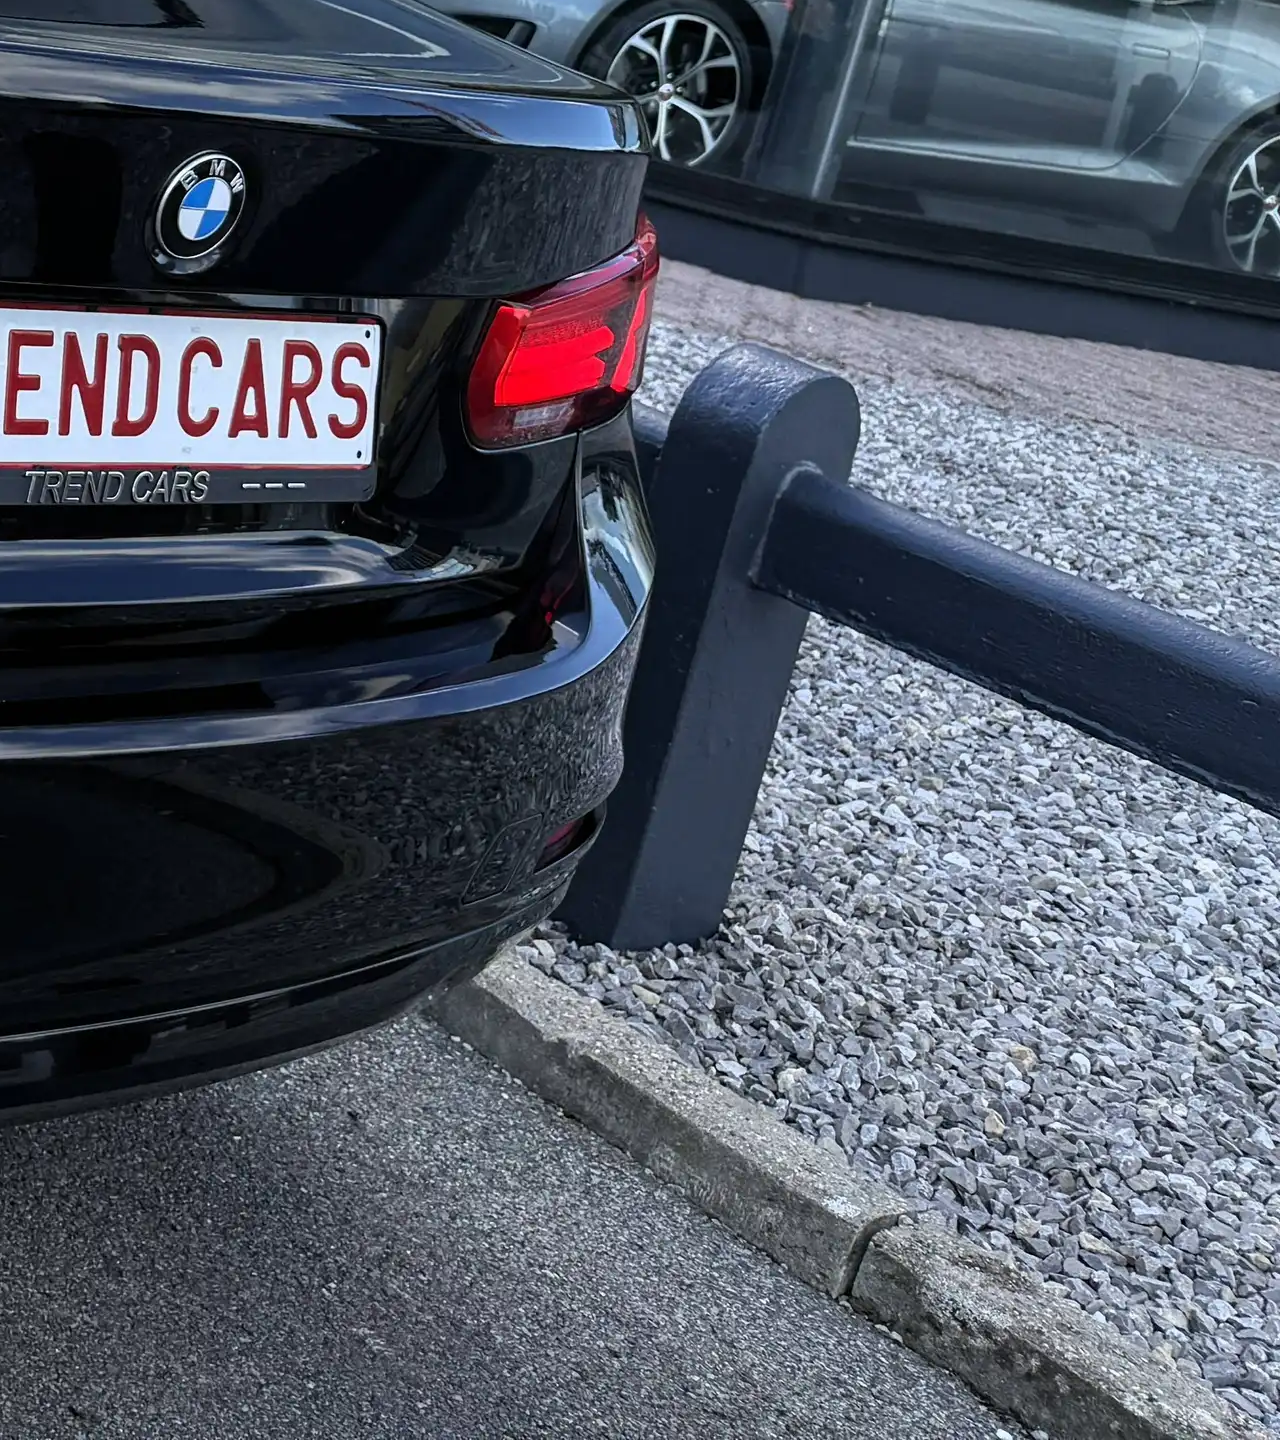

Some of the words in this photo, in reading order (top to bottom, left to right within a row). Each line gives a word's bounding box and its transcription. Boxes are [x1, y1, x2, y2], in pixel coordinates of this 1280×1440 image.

[180, 160, 244, 194] BMW
[25, 470, 125, 503] TREND
[131, 470, 211, 504] CARS
